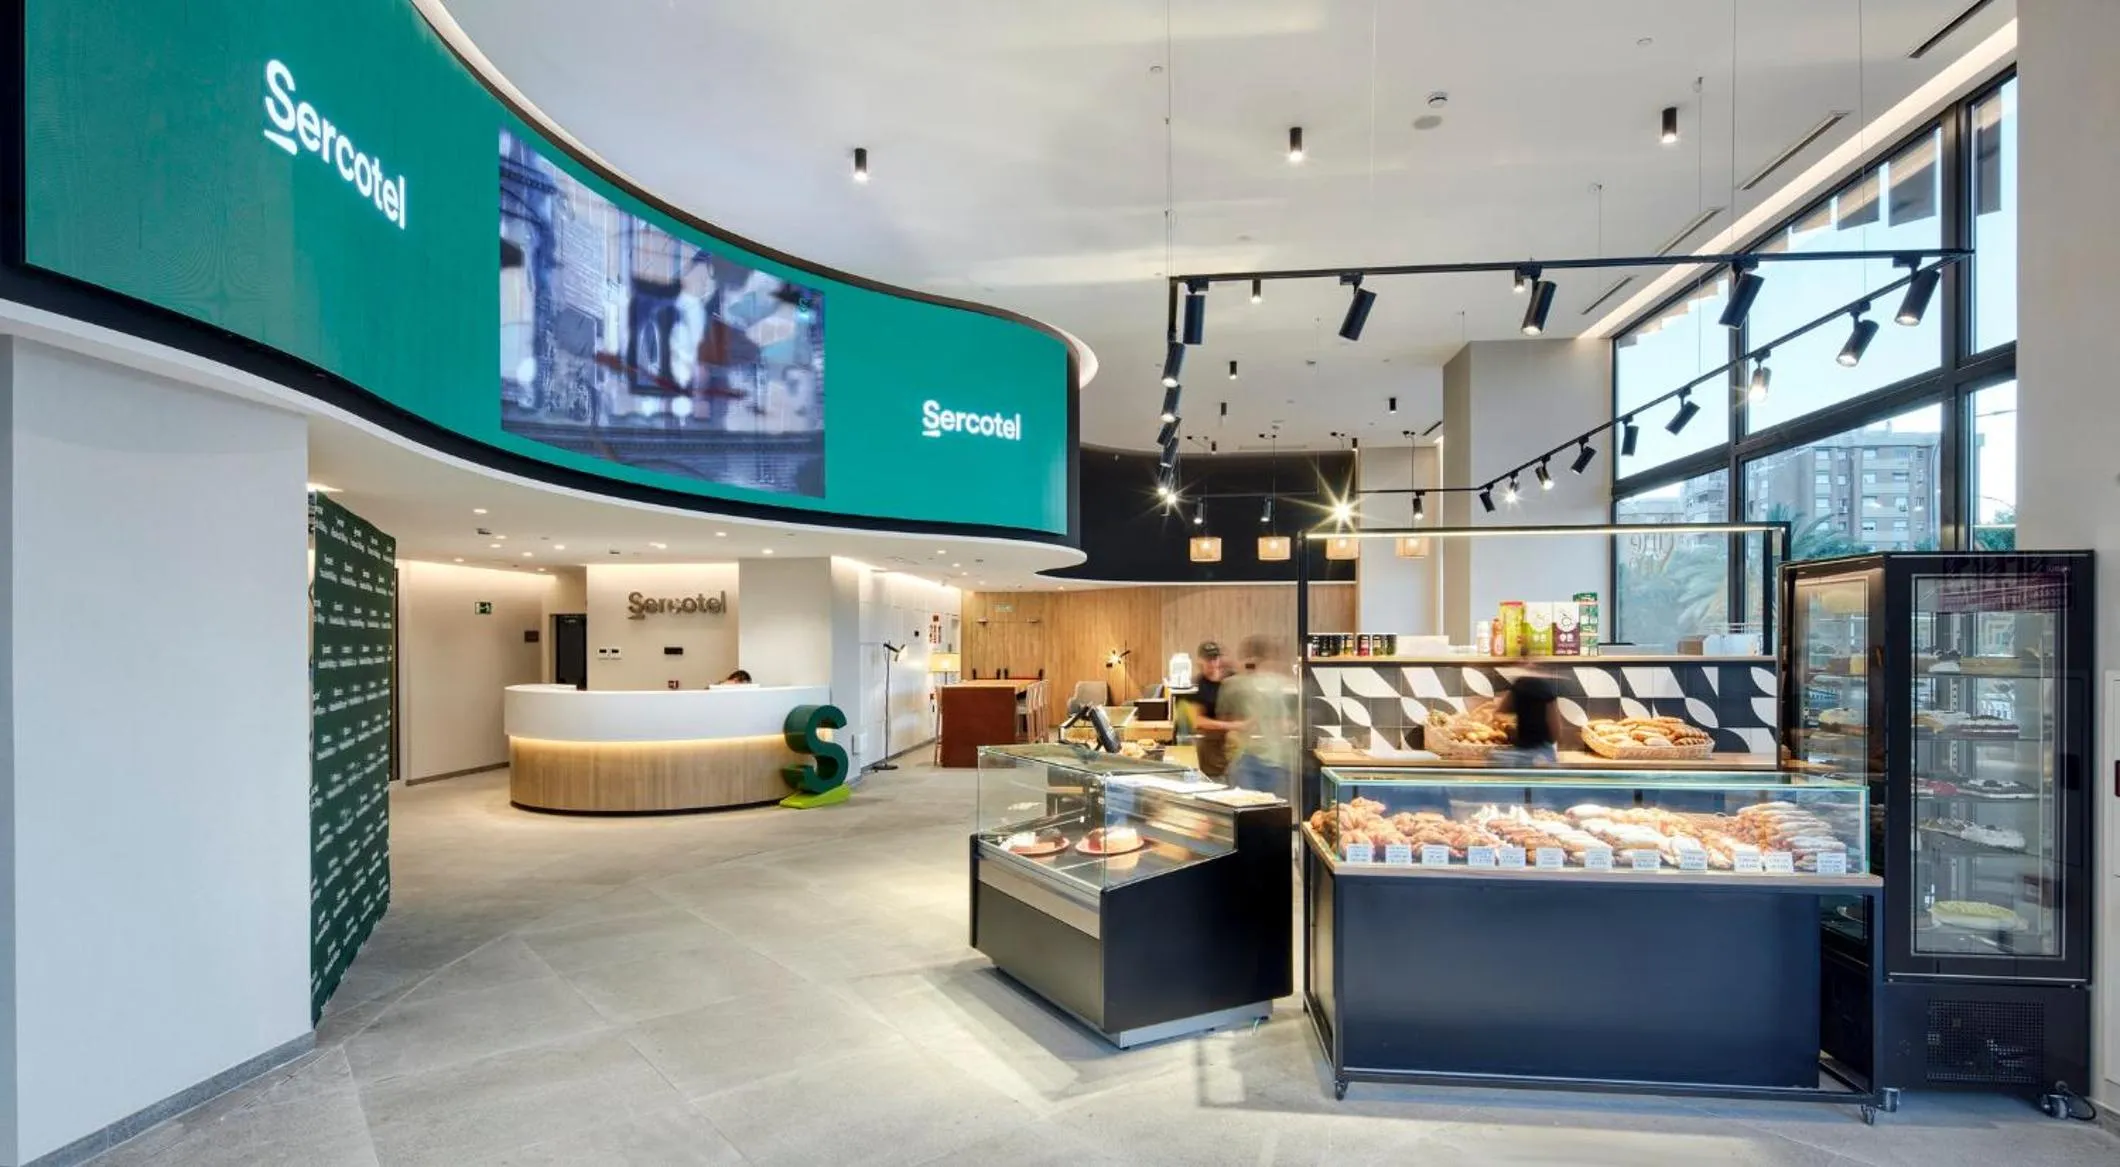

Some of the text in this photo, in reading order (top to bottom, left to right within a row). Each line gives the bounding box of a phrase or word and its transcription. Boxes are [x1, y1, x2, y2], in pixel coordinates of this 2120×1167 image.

[264, 59, 405, 229] Sercotel
[922, 399, 1021, 440] Sercotel
[628, 591, 727, 620] Sercotel
[782, 705, 849, 795] S
